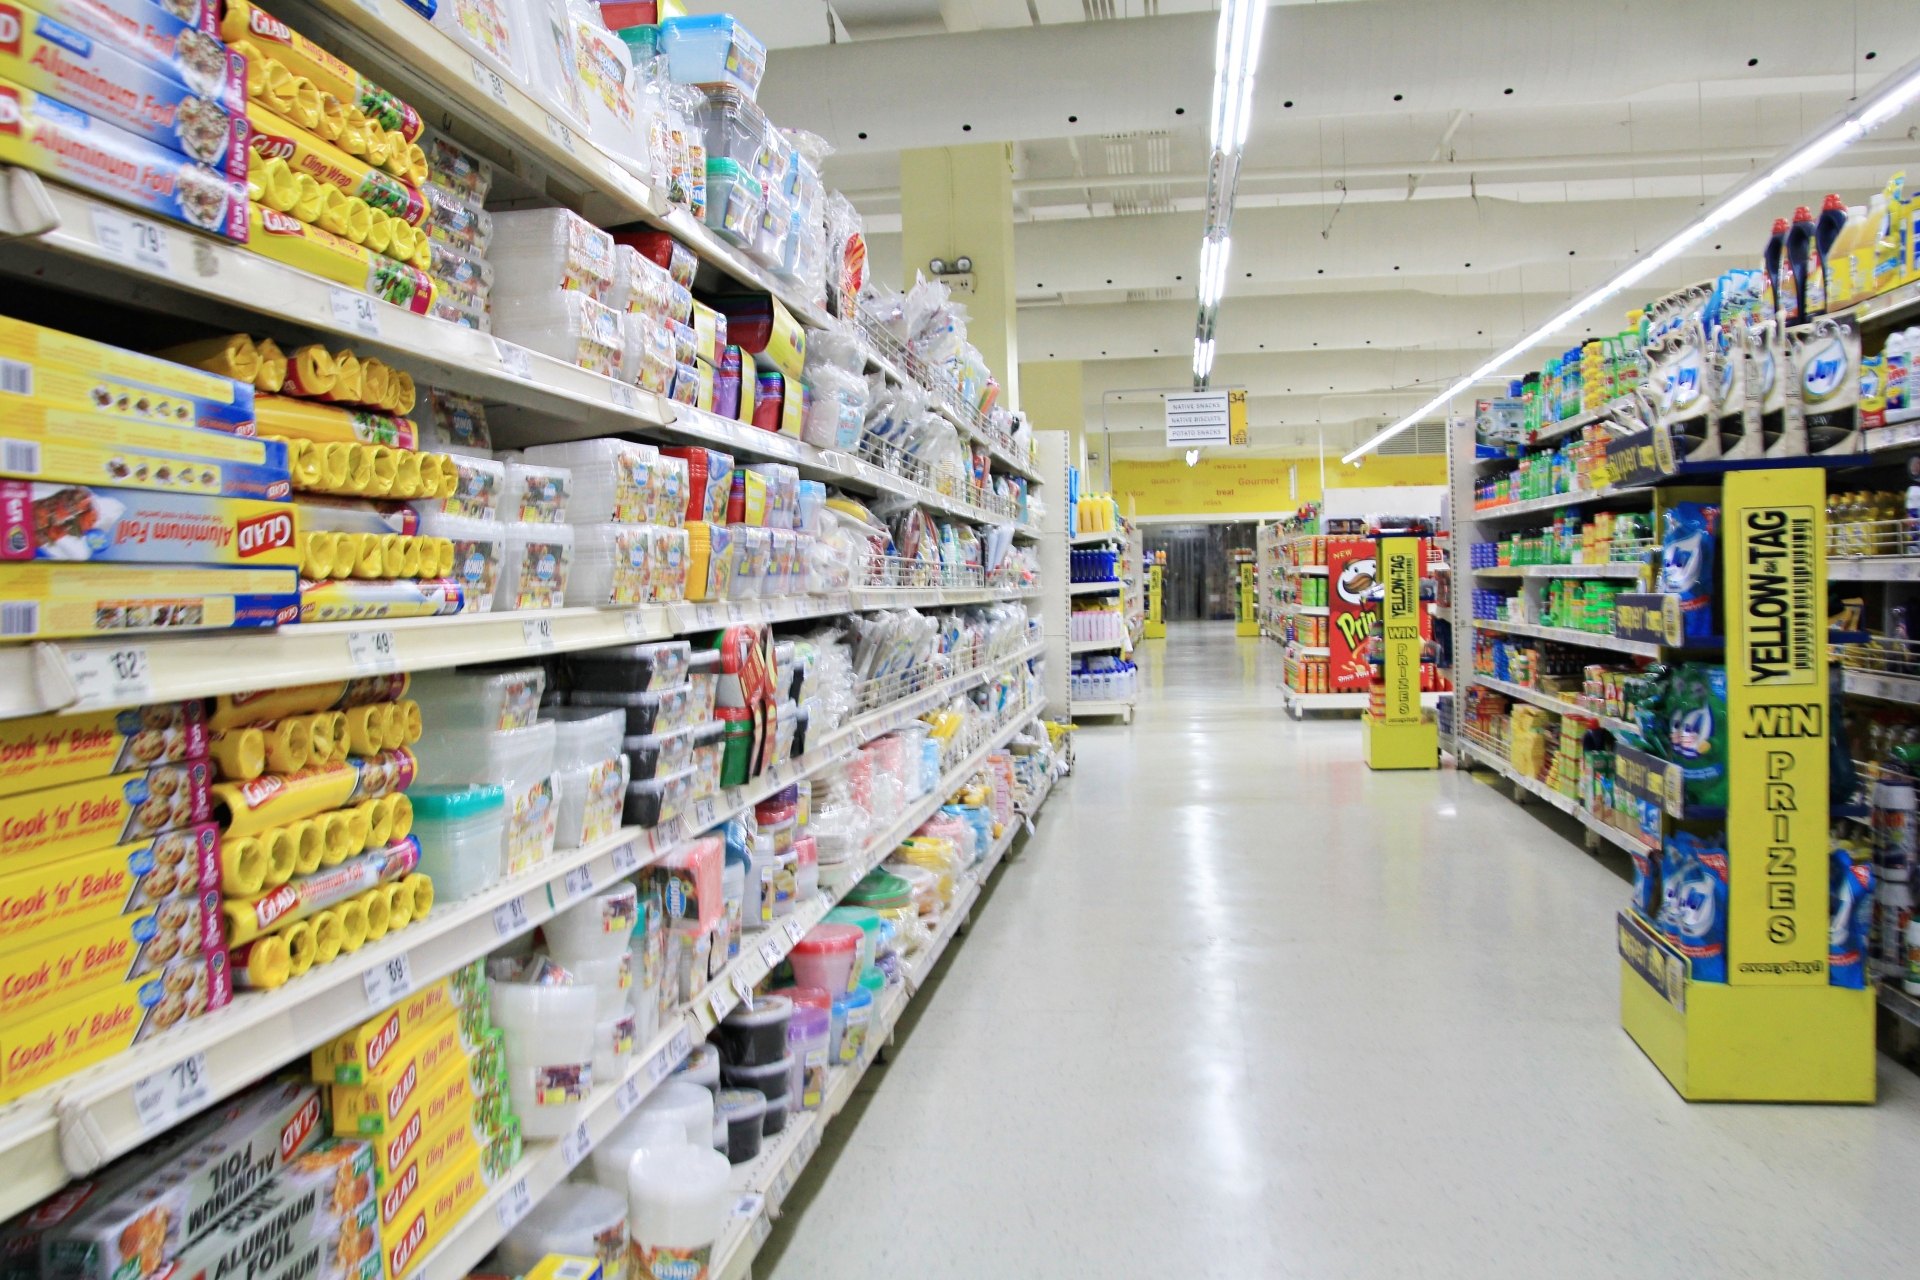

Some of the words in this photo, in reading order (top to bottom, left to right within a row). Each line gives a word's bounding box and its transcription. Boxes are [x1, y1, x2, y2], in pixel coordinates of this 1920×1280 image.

[251, 10, 291, 40] GLAD
[29, 44, 139, 112] Aluminum
[140, 93, 177, 127] Foil
[29, 124, 139, 181] Aluminum
[140, 166, 177, 196] Foil
[301, 154, 328, 178] Cling
[328, 168, 353, 187] Wrap
[263, 209, 302, 231] GLAD
[1229, 393, 1246, 403] 34
[267, 482, 290, 499] GLAD
[1239, 478, 1279, 486] Gourmet
[6, 499, 23, 524] 5
[113, 518, 151, 545] Foil
[153, 522, 235, 549] Aluminum
[238, 515, 292, 551] GLAD
[1748, 510, 1789, 565] TAG
[464, 560, 485, 575] BONUS
[536, 560, 556, 575] BONUS
[1333, 549, 1353, 560] NEW
[1390, 555, 1405, 575] TAG
[277, 604, 298, 622] GLAD
[1391, 579, 1406, 618] YELLOW
[375, 633, 390, 653] 49
[1336, 611, 1376, 651] Prin
[1750, 573, 1791, 683] YELLOW
[0, 732, 38, 764] ook
[69, 724, 114, 753] Bake
[242, 775, 281, 806] GLAD
[3, 807, 48, 843] Cook
[78, 795, 121, 825] Bake
[1766, 751, 1796, 945] PRIZES
[1, 885, 49, 924] Cook
[80, 866, 124, 900] Bake
[257, 887, 297, 928] GLAD
[670, 880, 680, 918] BONUS
[2, 960, 51, 1001] Cook
[83, 937, 128, 971] Bake
[406, 999, 424, 1024] Cling
[425, 986, 443, 1009] Wrap
[8, 1030, 57, 1075] Cook
[90, 1003, 134, 1038] Bake
[369, 1012, 399, 1070] GLAD
[422, 1046, 438, 1070] Cling
[438, 1031, 454, 1053] Wrap
[389, 1061, 416, 1119] GLAD
[428, 1094, 447, 1119] Cling
[447, 1078, 465, 1100] Wrap
[282, 1094, 320, 1154] GLAD
[389, 1115, 421, 1170] GLAD
[209, 1140, 253, 1193] FOIL
[426, 1144, 445, 1170] Cling
[446, 1124, 466, 1148] Wrap
[188, 1146, 277, 1237] ALUMINUM
[384, 1165, 417, 1224] GLAD
[434, 1193, 454, 1219] Cling
[455, 1173, 475, 1197] Wrap
[214, 1186, 316, 1280] ALUMINUM
[392, 1216, 425, 1277] GLAD
[246, 1230, 295, 1280] FOIL
